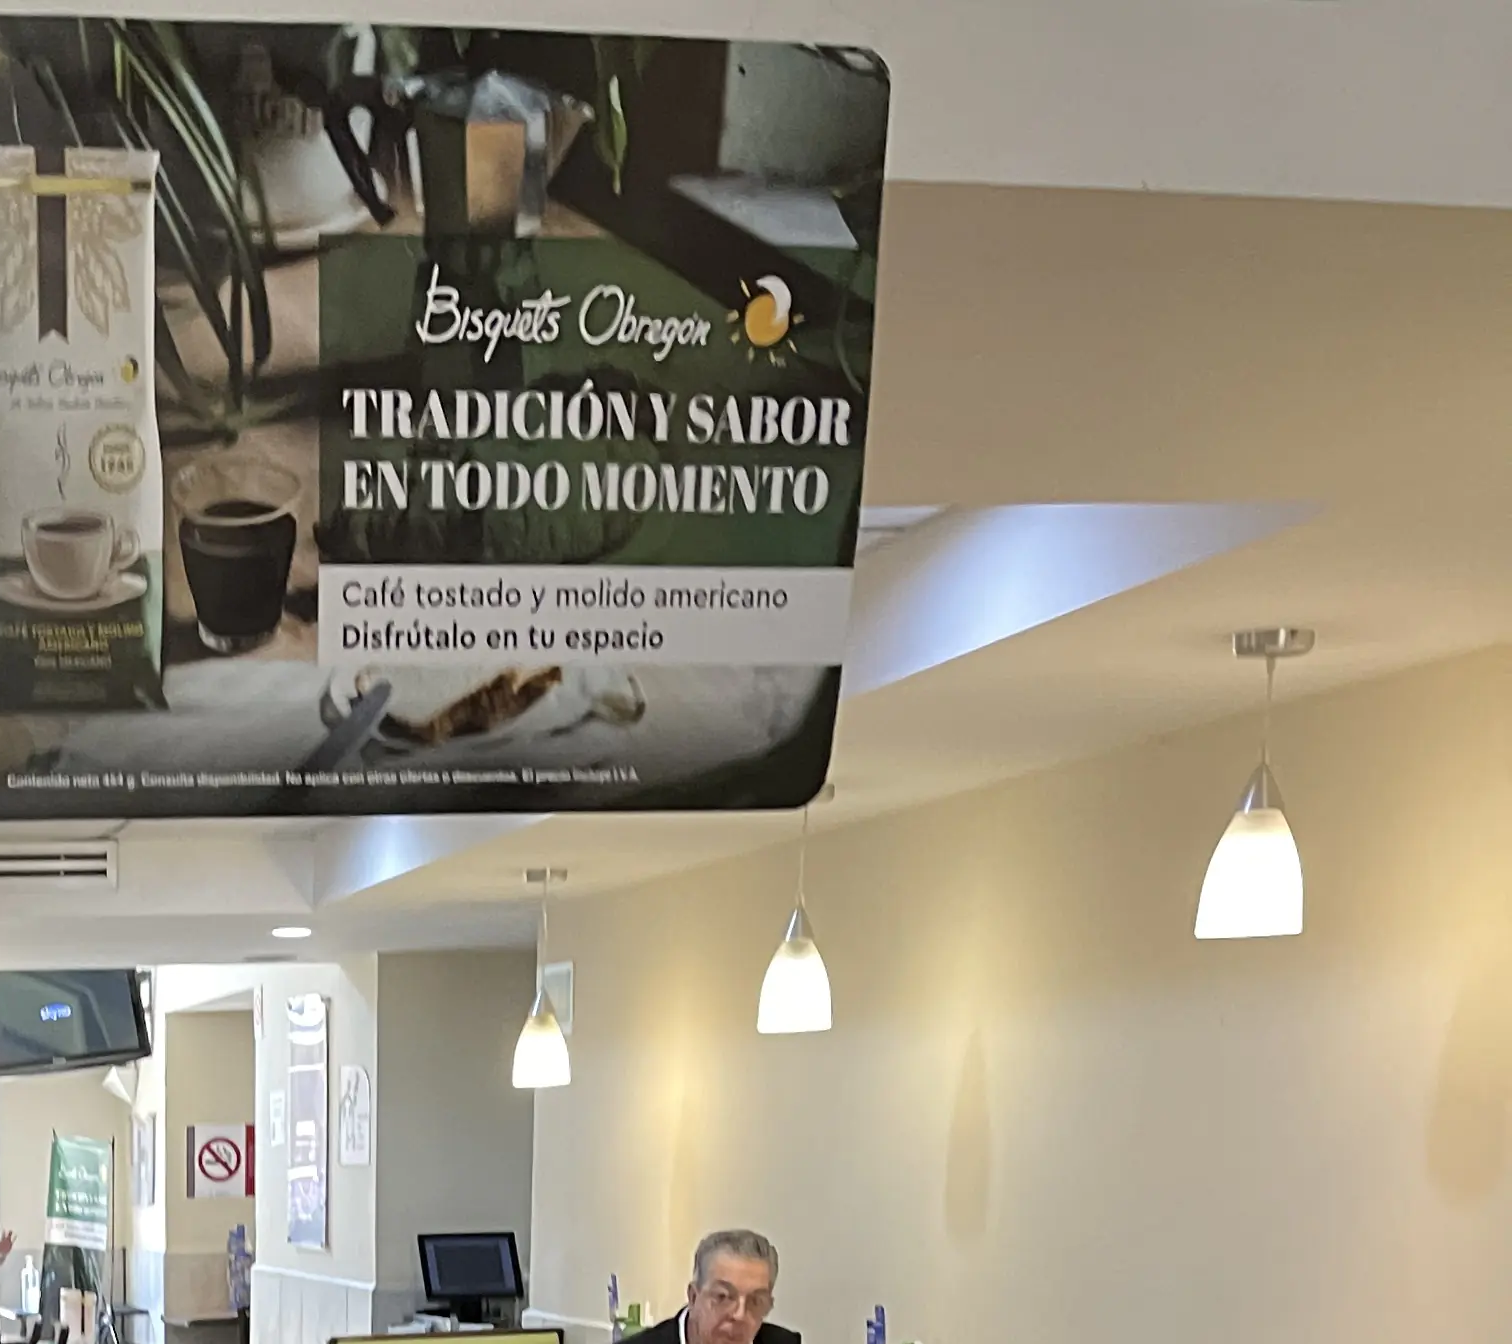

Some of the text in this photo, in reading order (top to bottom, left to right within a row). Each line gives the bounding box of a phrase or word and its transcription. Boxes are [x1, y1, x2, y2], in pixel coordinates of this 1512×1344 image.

[416, 263, 572, 363] Bisquets
[342, 379, 851, 446] TRADICIÓN Y SABOR
[343, 460, 830, 516] EN TODO MOMENTO
[341, 577, 789, 615] Café tostado y molido americano
[341, 621, 665, 656] Disfrútalo en tu espacio
